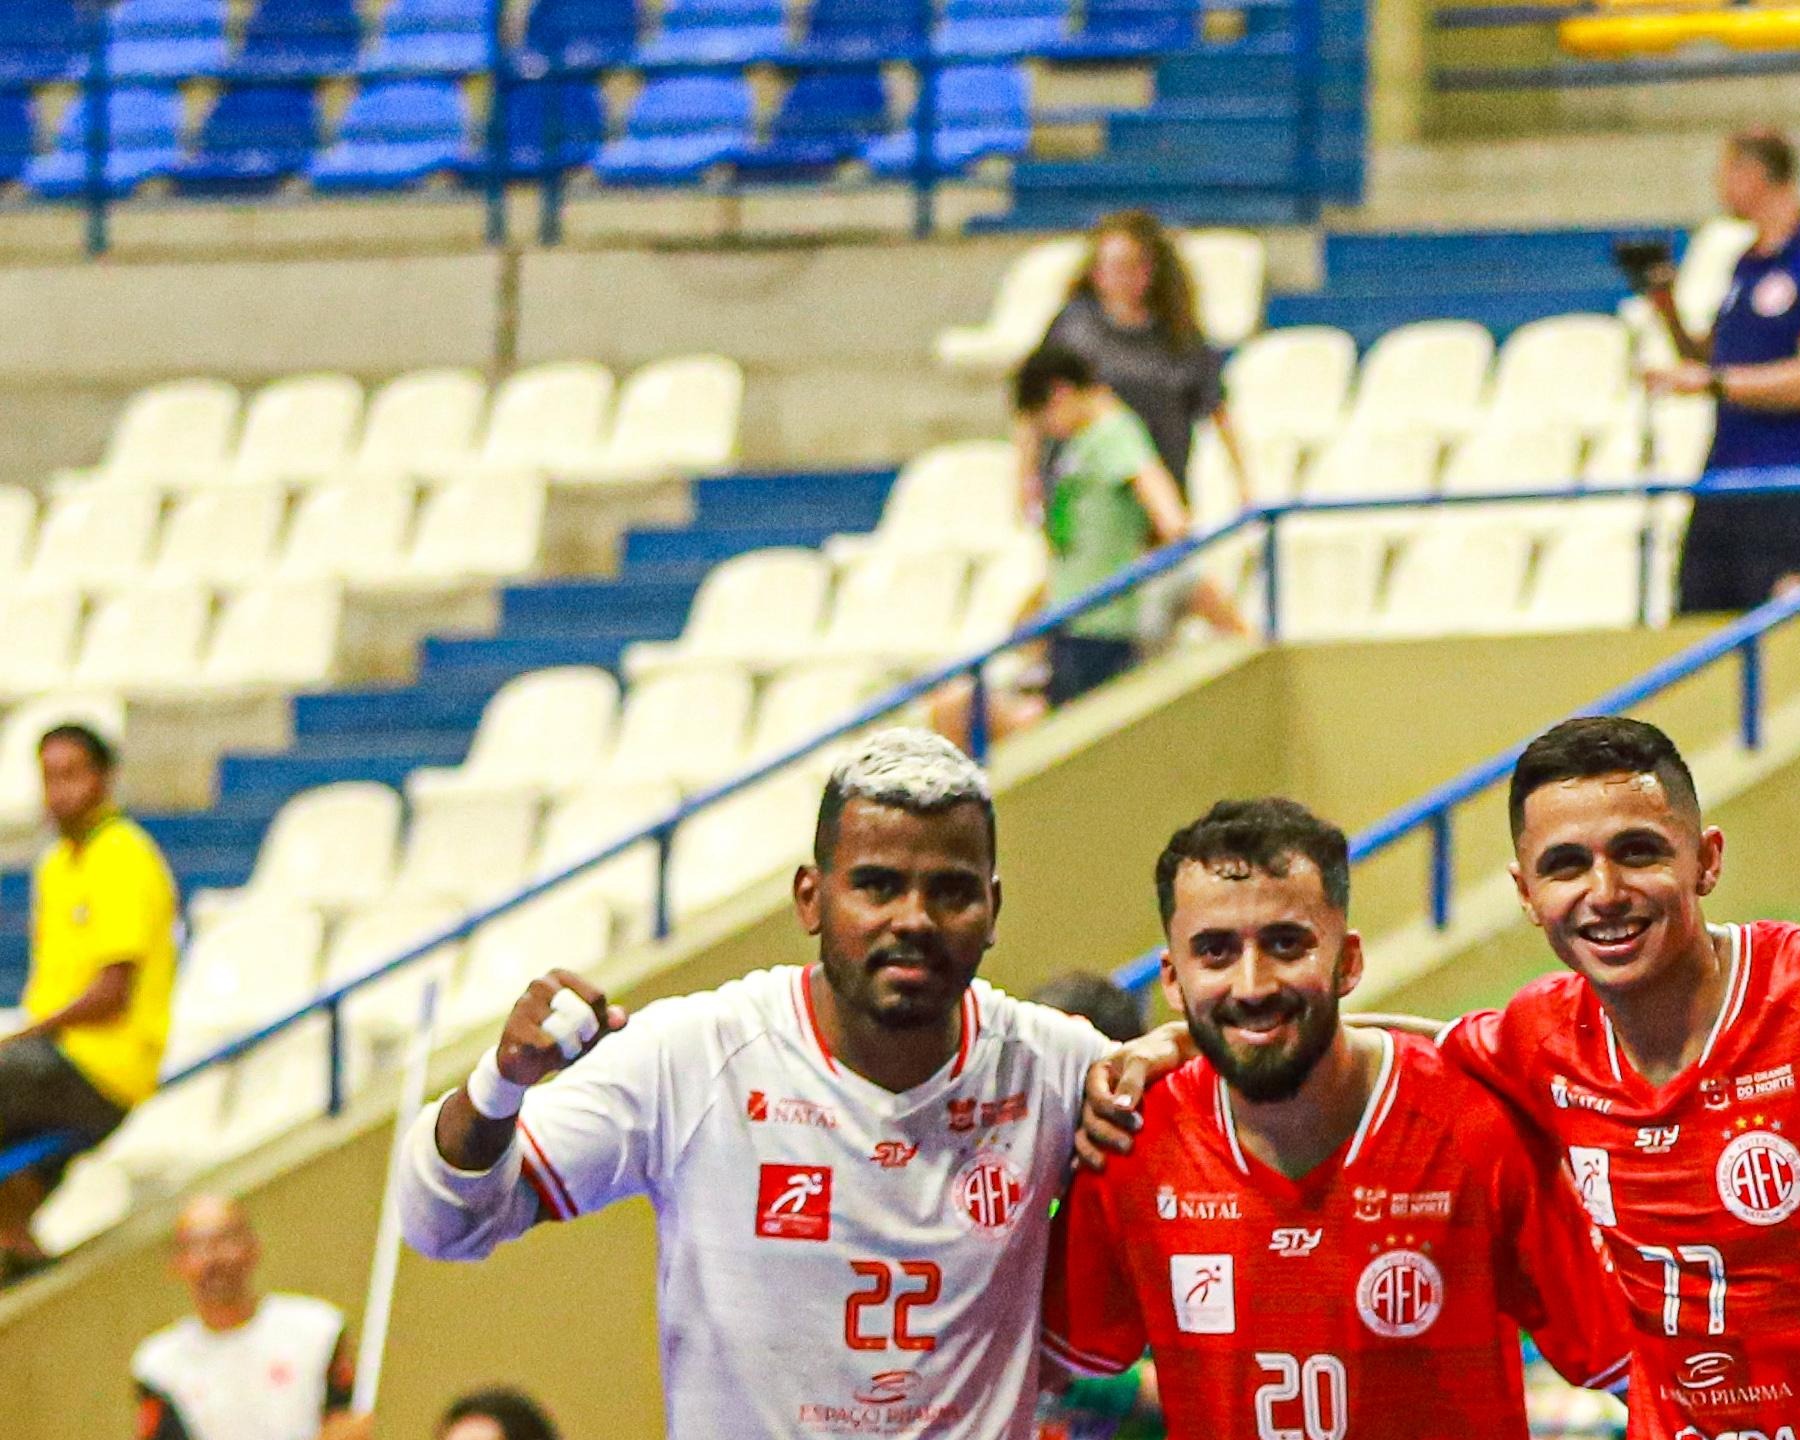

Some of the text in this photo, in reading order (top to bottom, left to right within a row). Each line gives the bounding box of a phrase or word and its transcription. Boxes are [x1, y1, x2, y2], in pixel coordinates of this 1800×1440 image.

[1736, 1073, 1795, 1101] DO NORTE
[1634, 1124, 1680, 1147] STY
[1730, 1146, 1793, 1210] AFC
[1180, 1199, 1243, 1220] NATAL
[1268, 1227, 1323, 1251] STY
[1371, 1264, 1430, 1326] AFC
[1636, 1245, 1728, 1336] 77
[844, 1259, 943, 1352] 22
[1711, 1381, 1794, 1405] PHARMA
